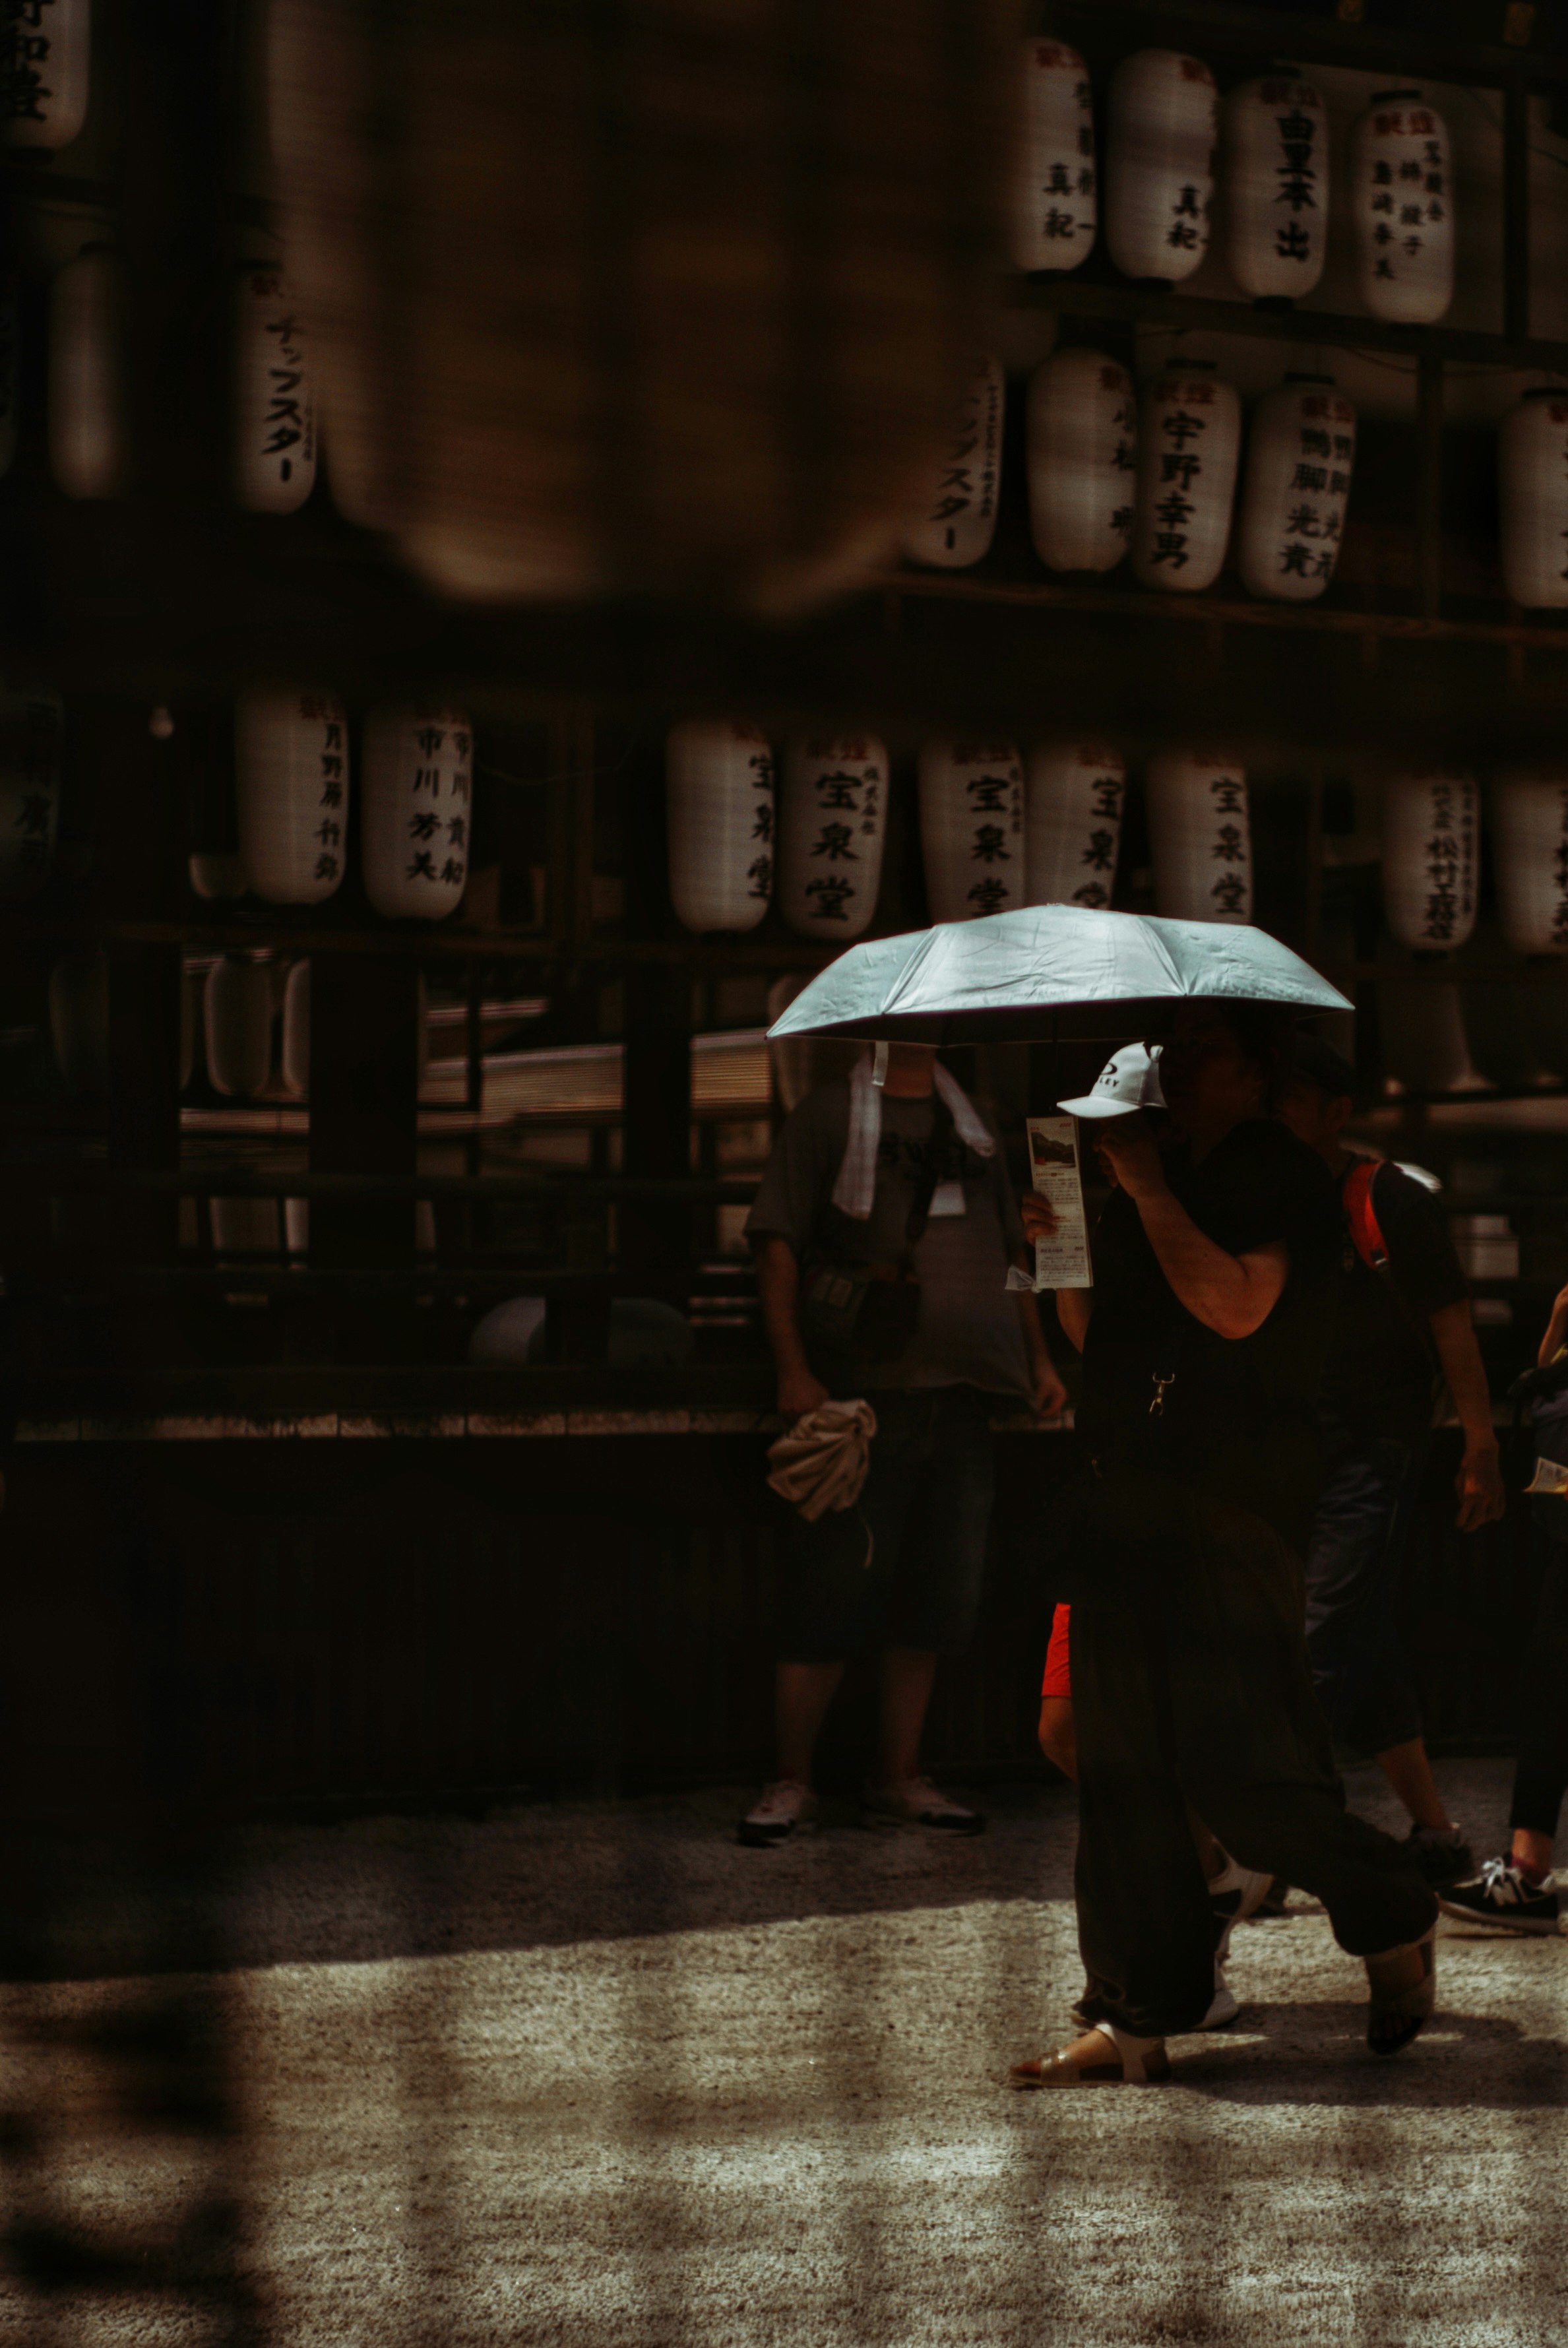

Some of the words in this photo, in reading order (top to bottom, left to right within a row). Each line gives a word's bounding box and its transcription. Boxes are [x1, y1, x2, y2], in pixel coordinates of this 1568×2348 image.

[1274, 108, 1317, 261] 由里本出
[1149, 409, 1206, 570] 宇野幸男
[405, 725, 446, 881] 市川芳美
[747, 751, 773, 899] 宝泉堂
[805, 770, 862, 921] 宝泉堂
[966, 775, 1011, 918] 宝泉堂
[1211, 776, 1247, 915] 宝泉堂
